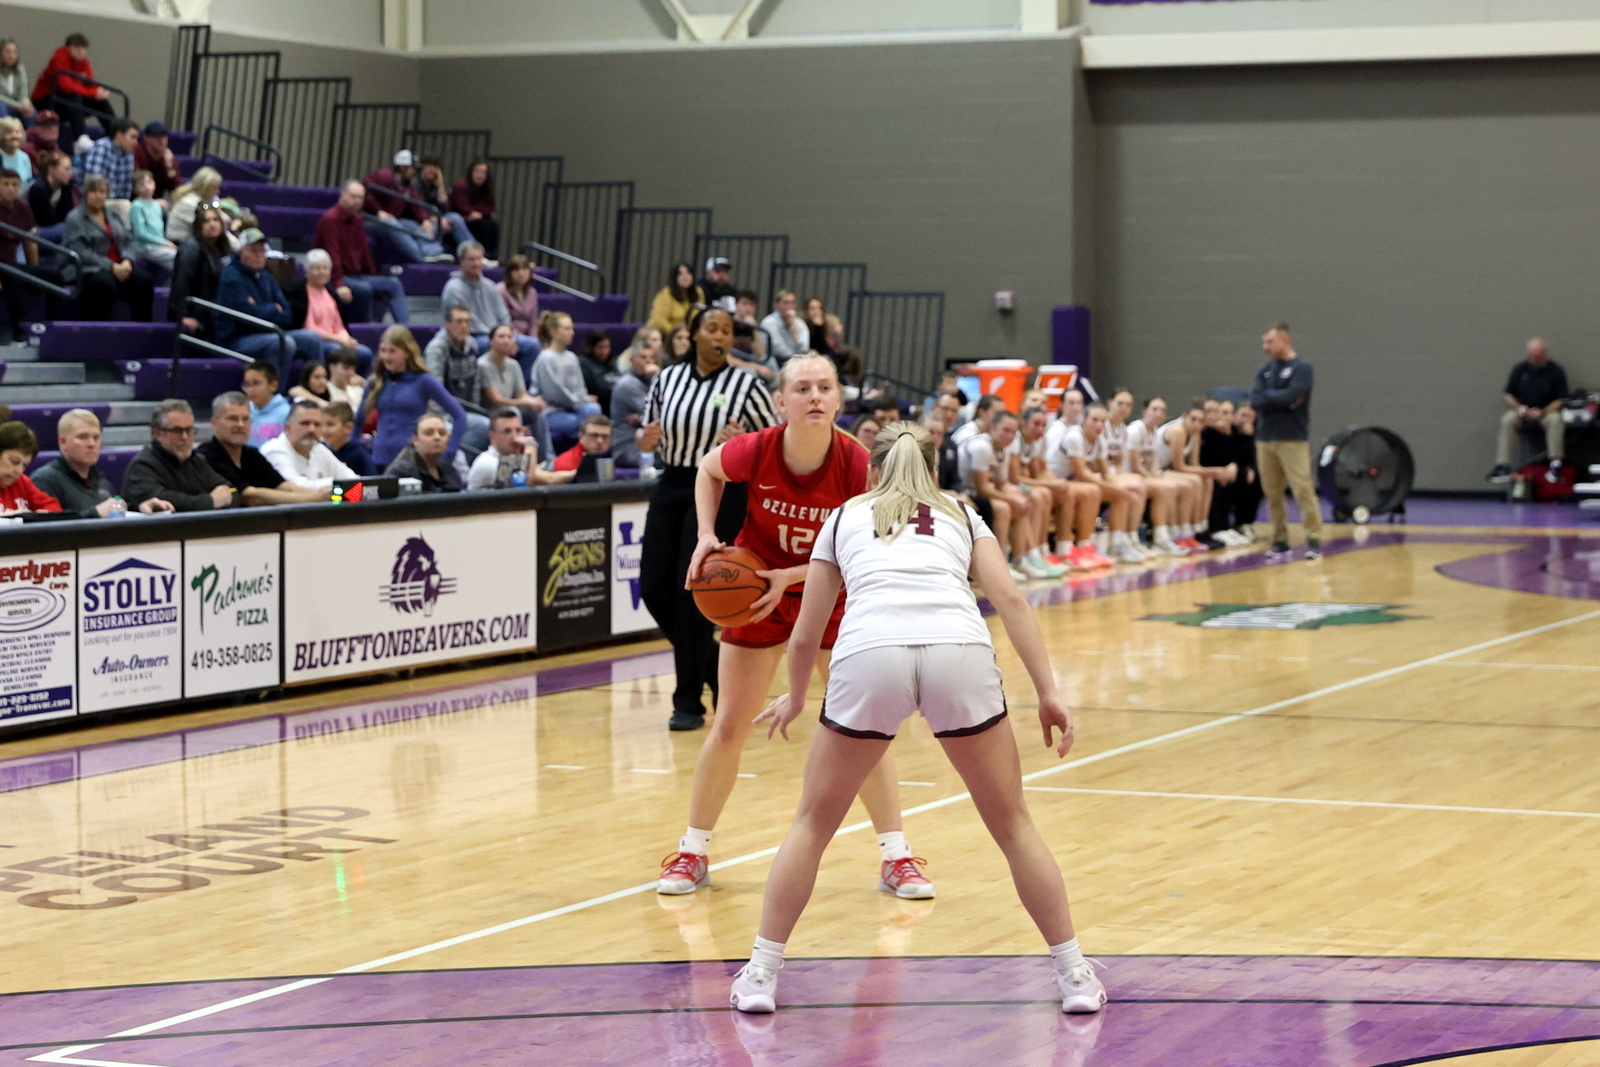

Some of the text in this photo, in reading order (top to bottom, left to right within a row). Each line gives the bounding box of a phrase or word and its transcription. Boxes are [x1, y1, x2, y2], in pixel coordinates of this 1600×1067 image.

[762, 498, 835, 523] BELLEVU
[777, 524, 815, 555] 12
[83, 574, 176, 613] STOLLY
[191, 562, 273, 635] Padrone's
[84, 607, 177, 631] INSURANCE GROUP
[236, 607, 269, 627] PIZZA
[191, 641, 273, 671] 419-358-0825
[293, 613, 531, 671] BLUFFTONBEAVERS.COM
[93, 654, 170, 675] Auto-Owners
[17, 827, 400, 911] COURT
